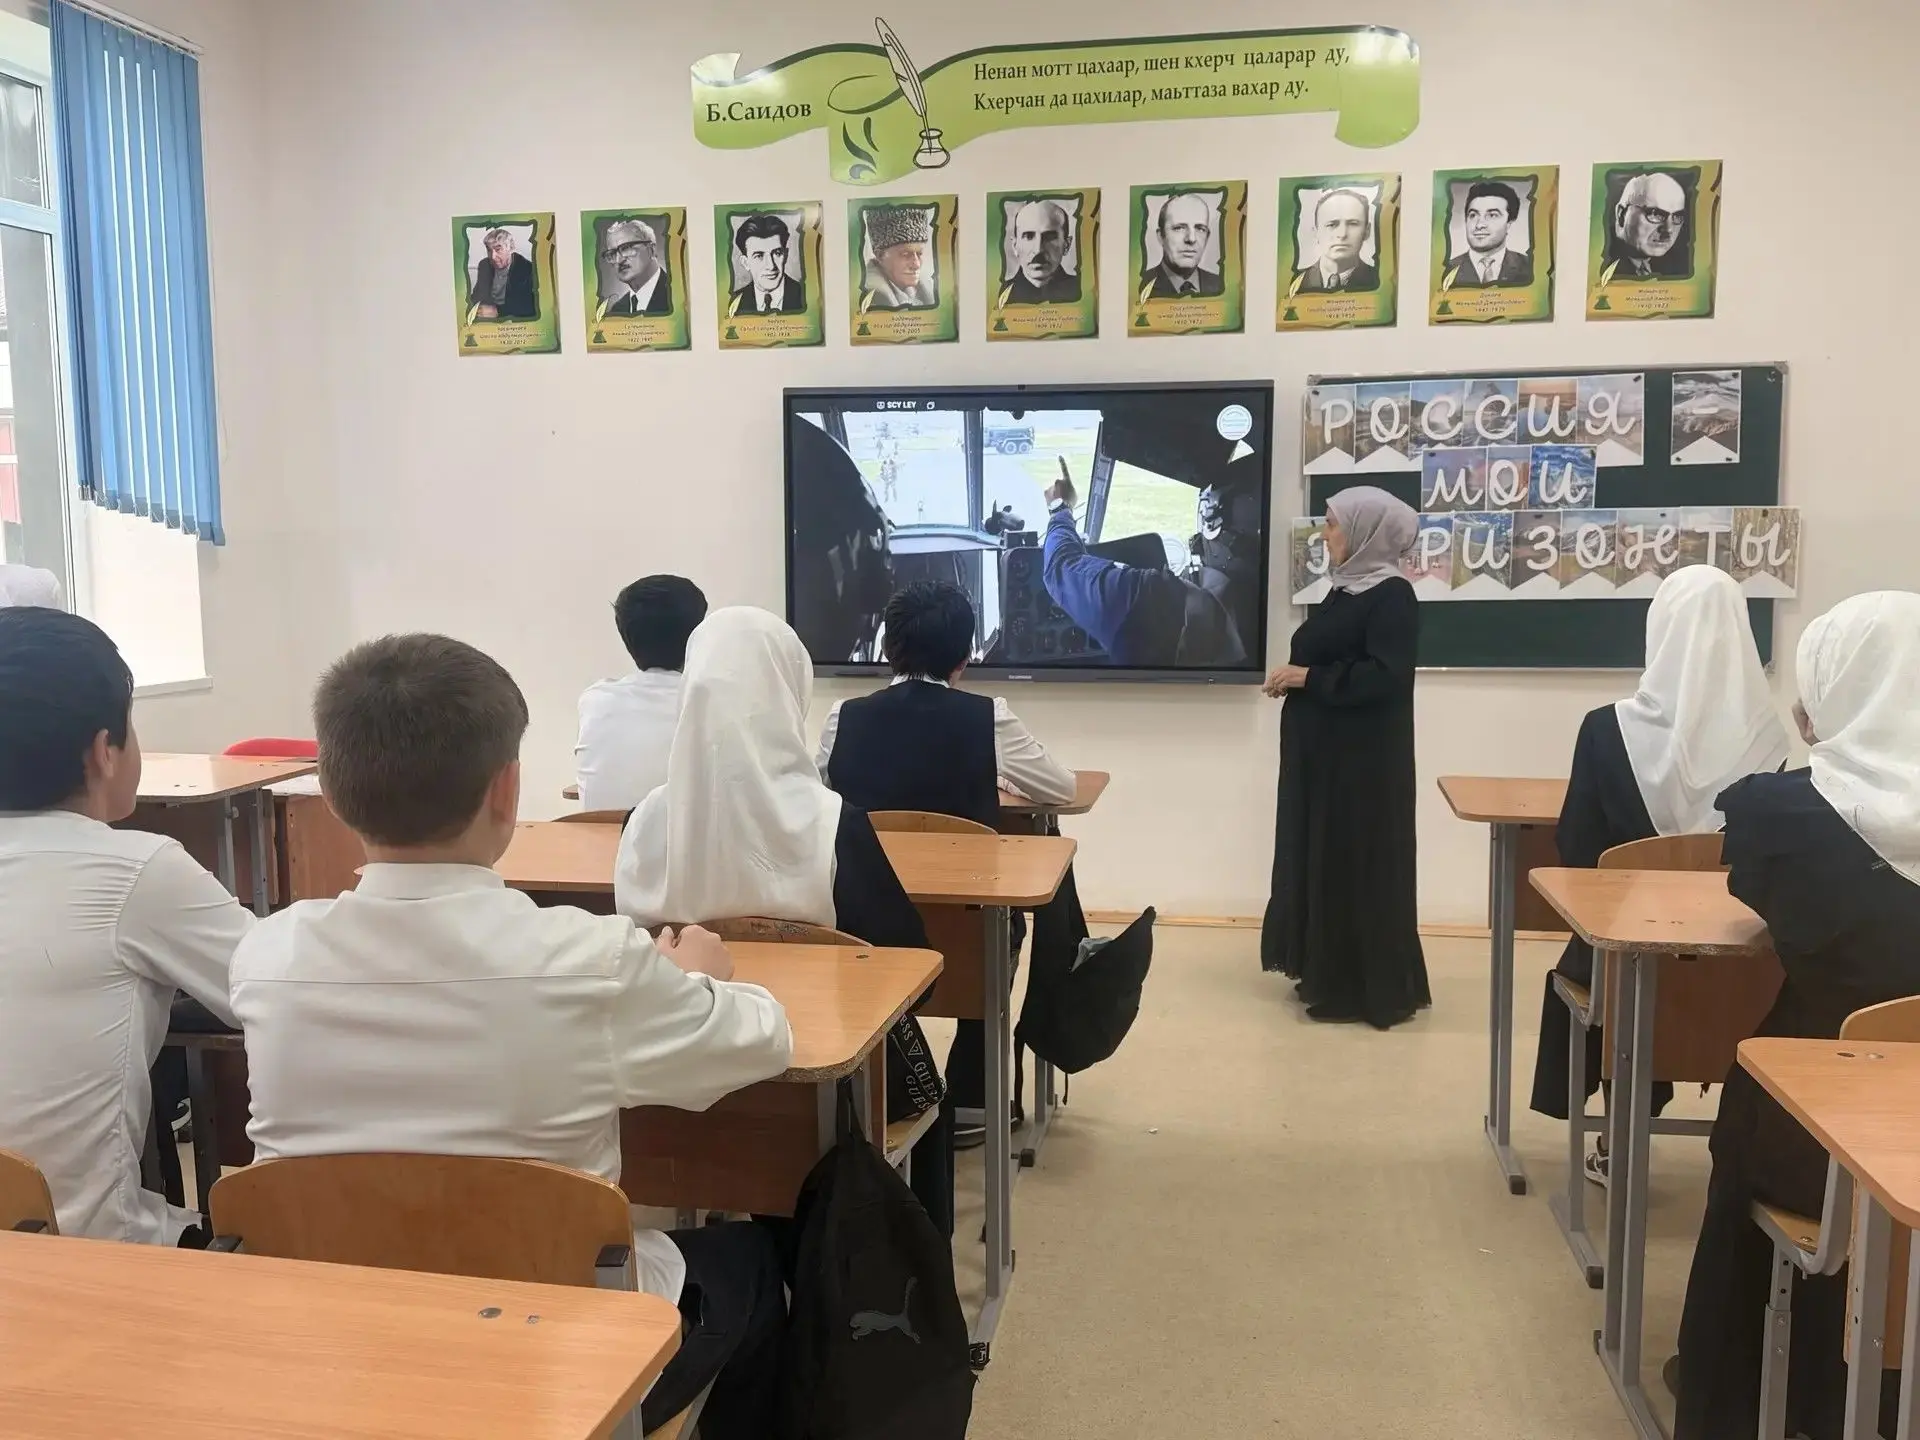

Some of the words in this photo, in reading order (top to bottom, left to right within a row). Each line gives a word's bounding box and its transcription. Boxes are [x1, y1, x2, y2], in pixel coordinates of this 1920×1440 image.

[974, 63, 1027, 81] Ненан
[1031, 63, 1072, 78] мотт
[1077, 58, 1140, 78] цахаар,
[1144, 56, 1179, 71] шен
[1184, 53, 1235, 73] кхерч
[1243, 48, 1316, 70] цаларар
[1325, 47, 1350, 67] ду,
[706, 101, 812, 123] Б.Саидов
[974, 92, 1045, 114] Кхерчан
[1049, 95, 1068, 110] да
[1073, 88, 1147, 108] цахилар,
[1151, 83, 1227, 101] маьттаза
[1231, 80, 1280, 100] вахар
[1284, 79, 1309, 99] ду.
[900, 1013, 914, 1041] ESS
[905, 1075, 931, 1111] GUES
